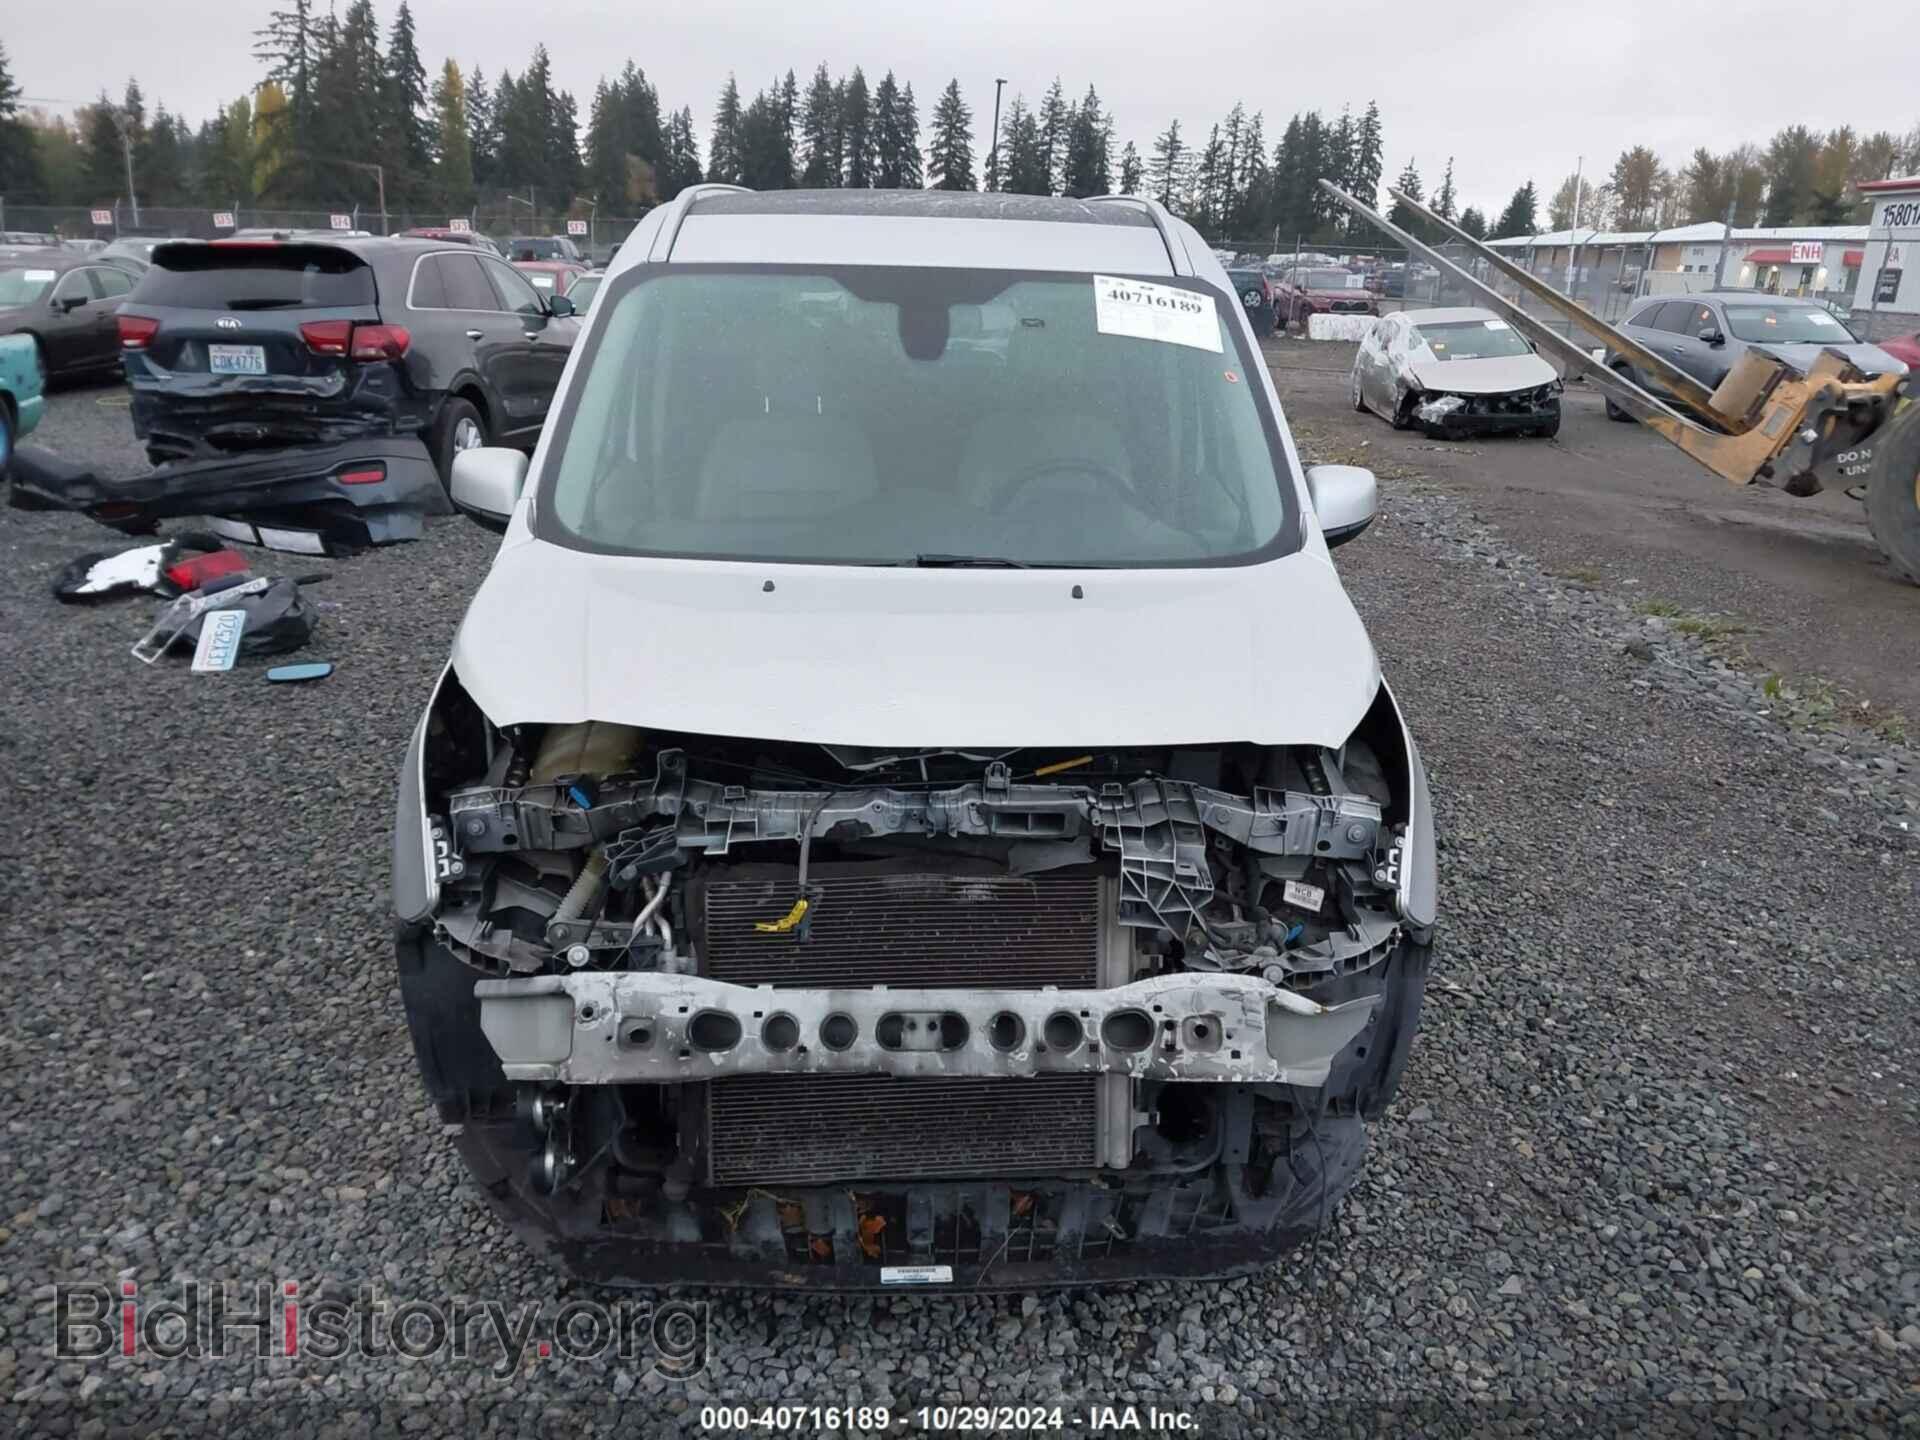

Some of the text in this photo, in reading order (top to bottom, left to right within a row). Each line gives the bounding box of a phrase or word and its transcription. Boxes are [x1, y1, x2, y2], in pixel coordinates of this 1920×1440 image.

[1792, 244, 1820, 259] ENH
[1107, 289, 1202, 313] 40716189
[1837, 451, 1858, 463] DO
